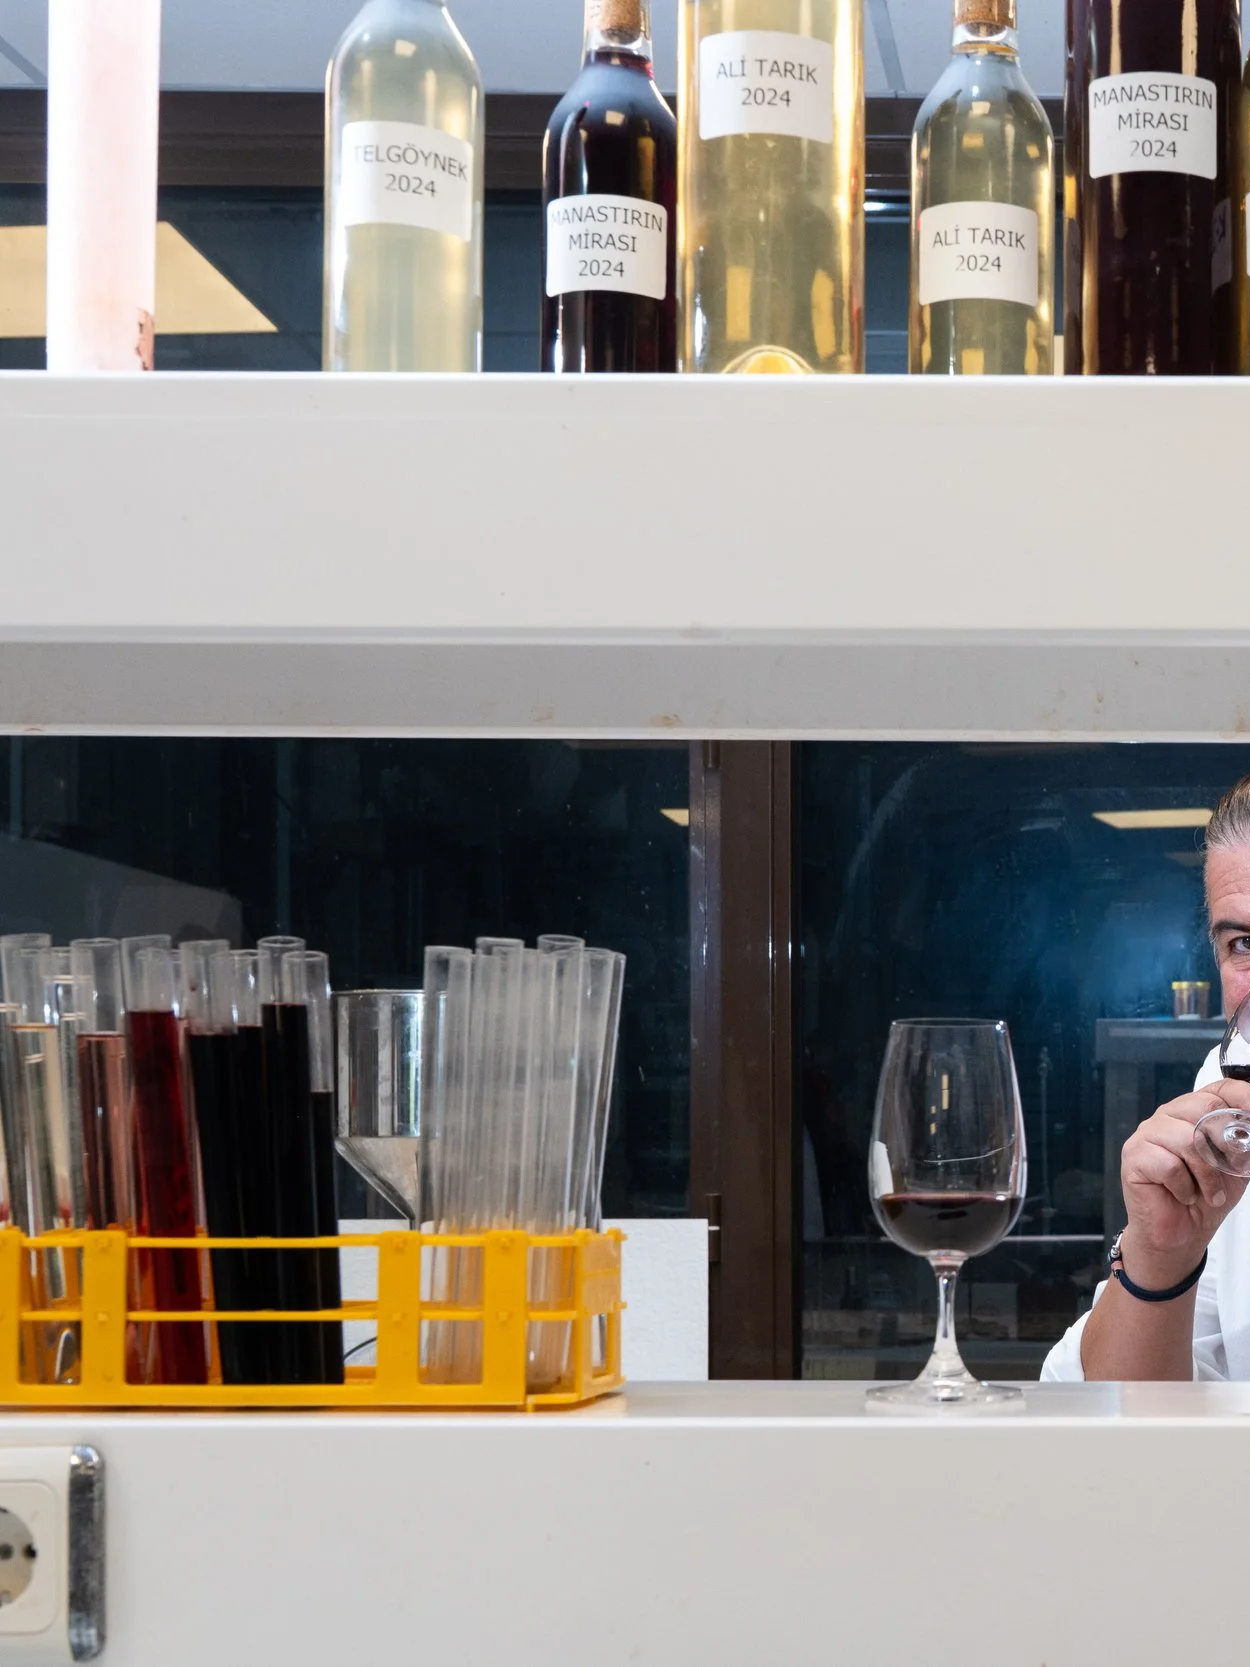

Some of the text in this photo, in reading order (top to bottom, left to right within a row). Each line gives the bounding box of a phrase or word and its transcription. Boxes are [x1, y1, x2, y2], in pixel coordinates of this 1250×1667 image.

[717, 55, 817, 85] ALİ TARIK
[741, 87, 791, 108] 2024
[1094, 84, 1213, 110] MANASTIRIN
[1118, 108, 1188, 131] MİRASI
[1129, 139, 1177, 158] 2024
[354, 142, 468, 182] TELGÖYNEK
[384, 173, 436, 198] 2024
[551, 205, 663, 233] MANASTIRIN
[568, 229, 637, 252] MİRASI
[932, 224, 1025, 250] ALİ TARIK
[578, 259, 625, 278] 2024
[955, 254, 1002, 273] 2024
